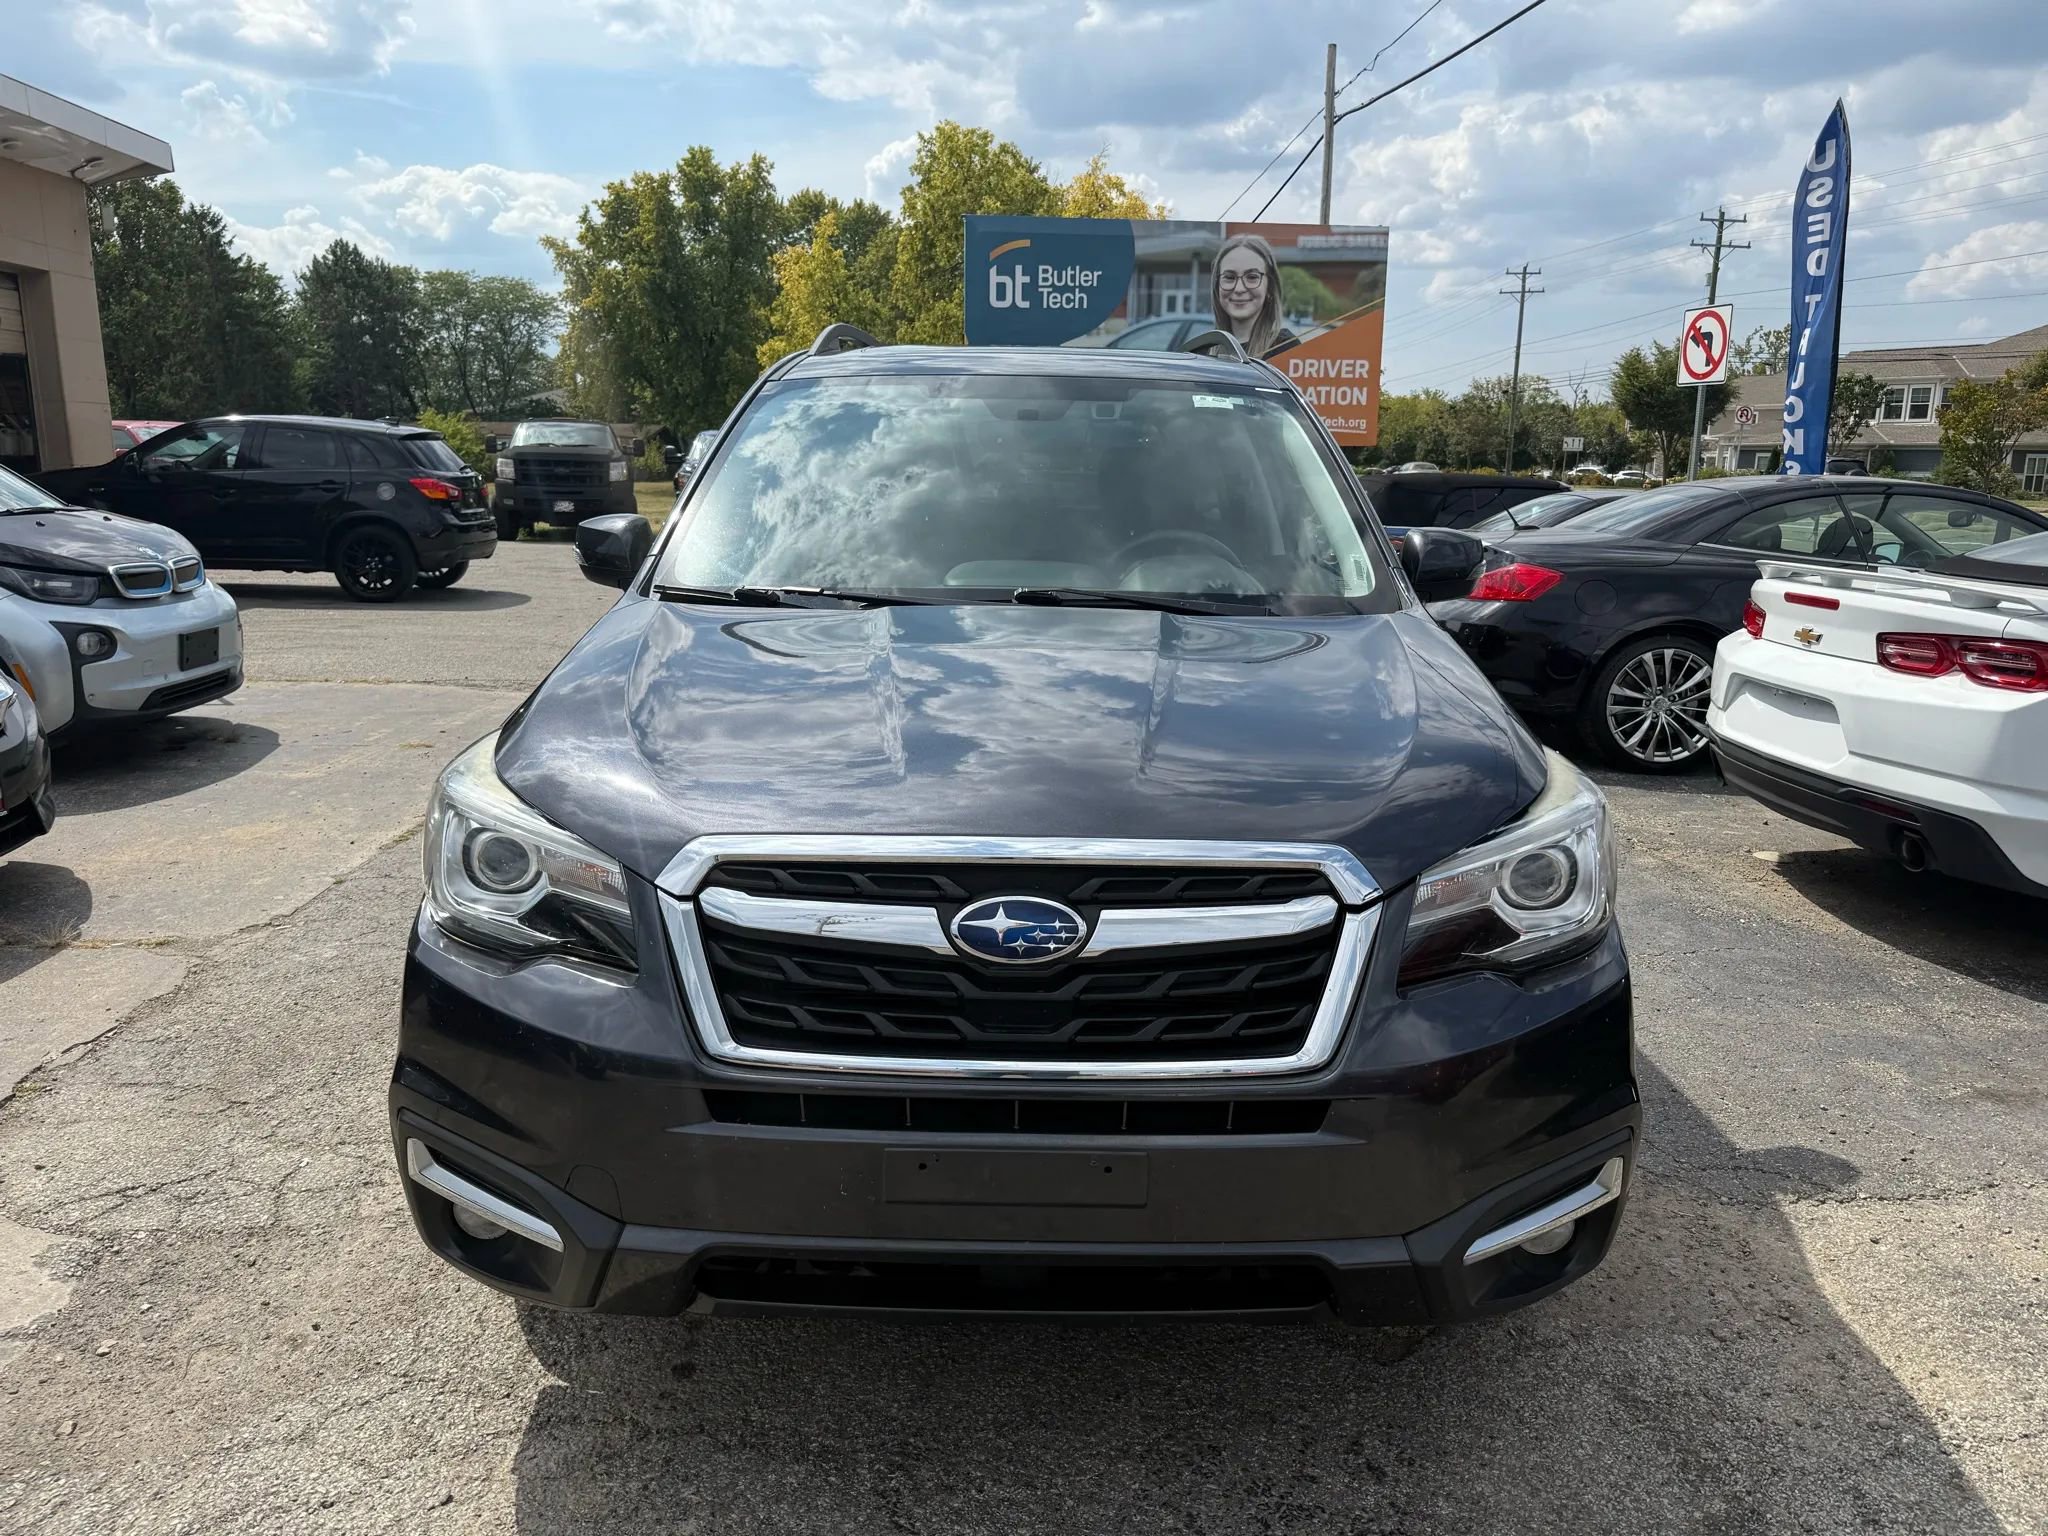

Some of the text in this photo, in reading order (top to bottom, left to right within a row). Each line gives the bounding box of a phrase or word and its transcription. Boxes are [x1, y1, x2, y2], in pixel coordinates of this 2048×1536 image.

[1038, 265, 1102, 286] Butler
[989, 265, 1031, 308] bt
[1038, 288, 1088, 309] Tech
[1288, 359, 1369, 379] DRIVER
[1297, 386, 1368, 406] ATION
